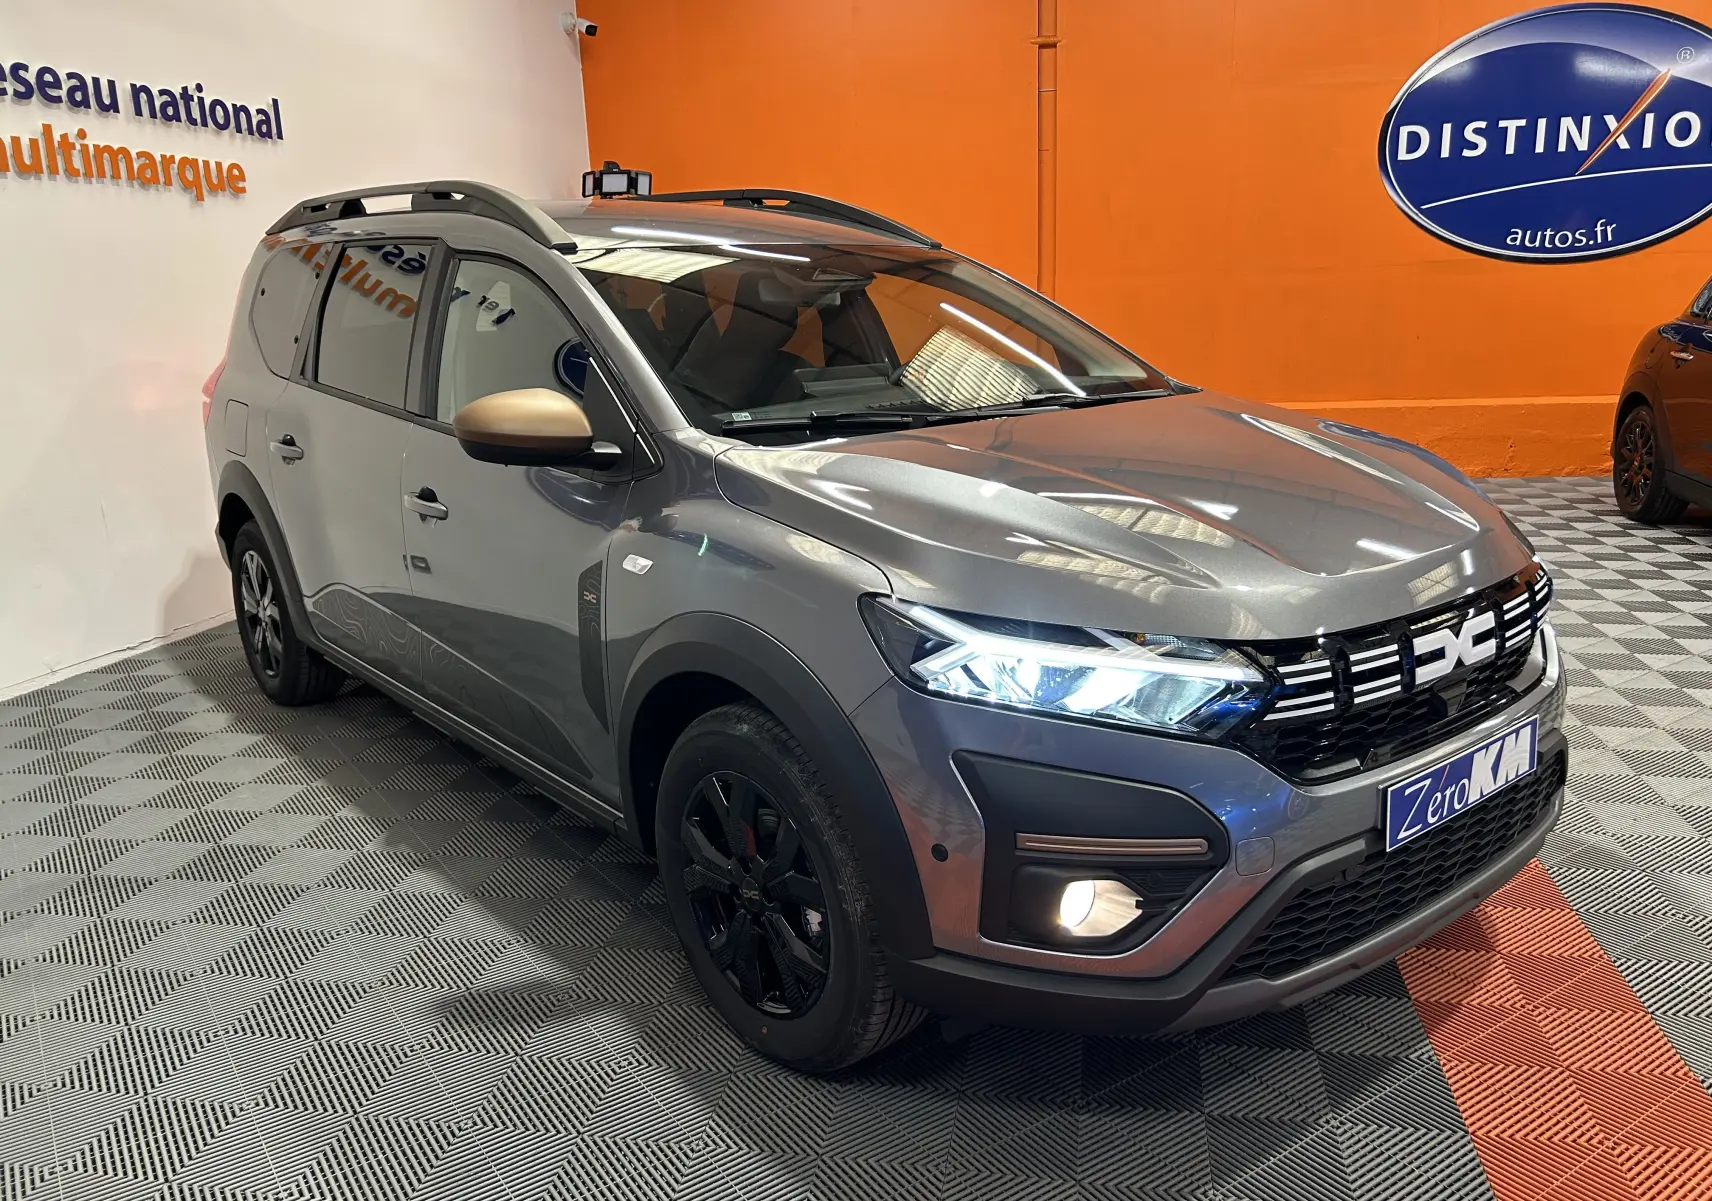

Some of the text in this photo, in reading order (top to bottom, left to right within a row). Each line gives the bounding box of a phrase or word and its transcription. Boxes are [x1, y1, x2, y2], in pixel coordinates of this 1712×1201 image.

[129, 82, 284, 141] national
[1396, 110, 1712, 161] DISTINXIO
[0, 122, 247, 202] ultimarque
[1505, 218, 1617, 249] autos.fr
